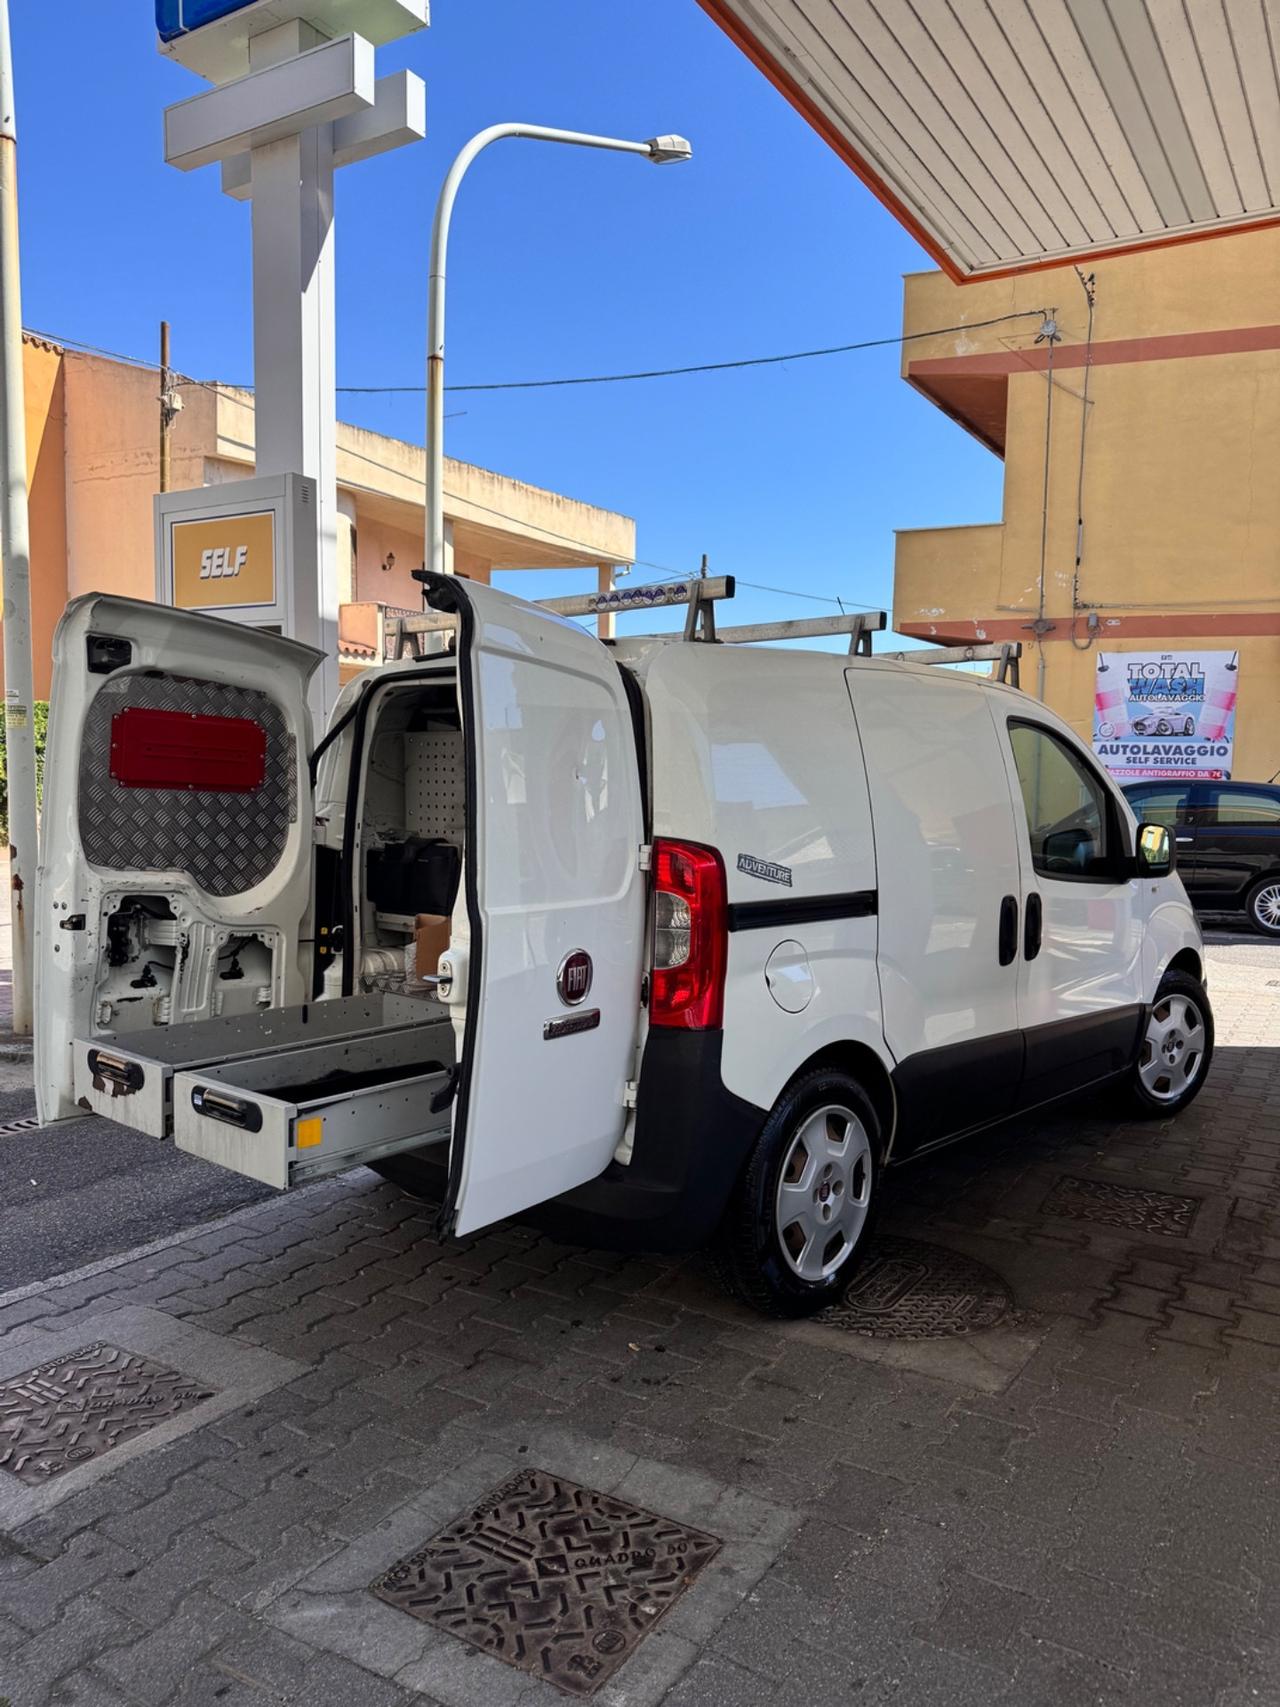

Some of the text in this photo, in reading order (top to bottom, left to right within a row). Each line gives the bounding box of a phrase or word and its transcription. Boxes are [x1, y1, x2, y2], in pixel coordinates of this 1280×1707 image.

[200, 545, 248, 579] SELF
[1128, 662, 1205, 679] TOTAL
[1127, 677, 1205, 695] WASH
[1128, 694, 1205, 702] AUTOLAVAGGIO
[1098, 744, 1229, 757] AUTOLAVAGGIO
[1126, 756, 1197, 765] SELF SERVICE
[1141, 769, 1196, 778] ANTIGRAFFIO
[739, 857, 791, 882] ADVENTURE
[568, 965, 588, 992] FIAT
